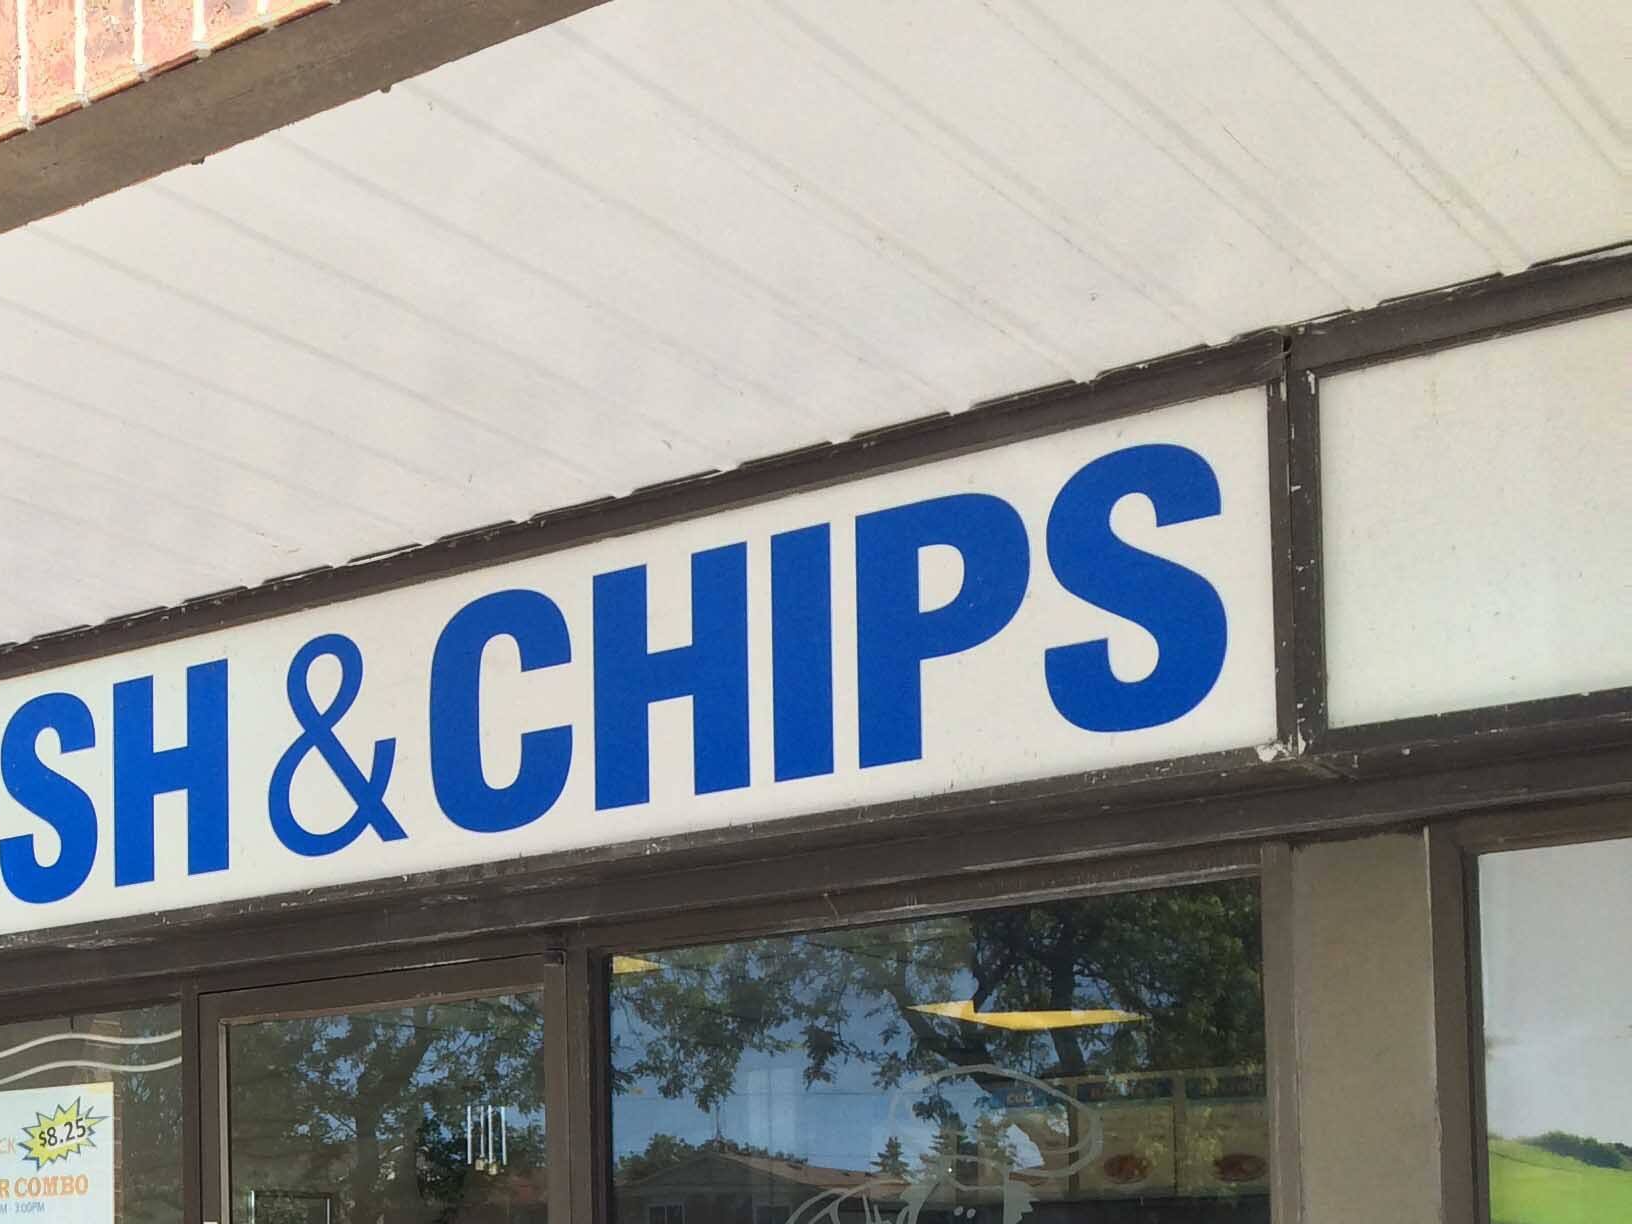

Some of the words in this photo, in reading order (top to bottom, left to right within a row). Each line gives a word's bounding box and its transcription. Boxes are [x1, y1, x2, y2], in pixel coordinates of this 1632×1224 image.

[268, 633, 407, 857] &
[429, 443, 1228, 834] CHIPS
[38, 1117, 87, 1148] $8.25
[14, 1173, 89, 1198] COMBO
